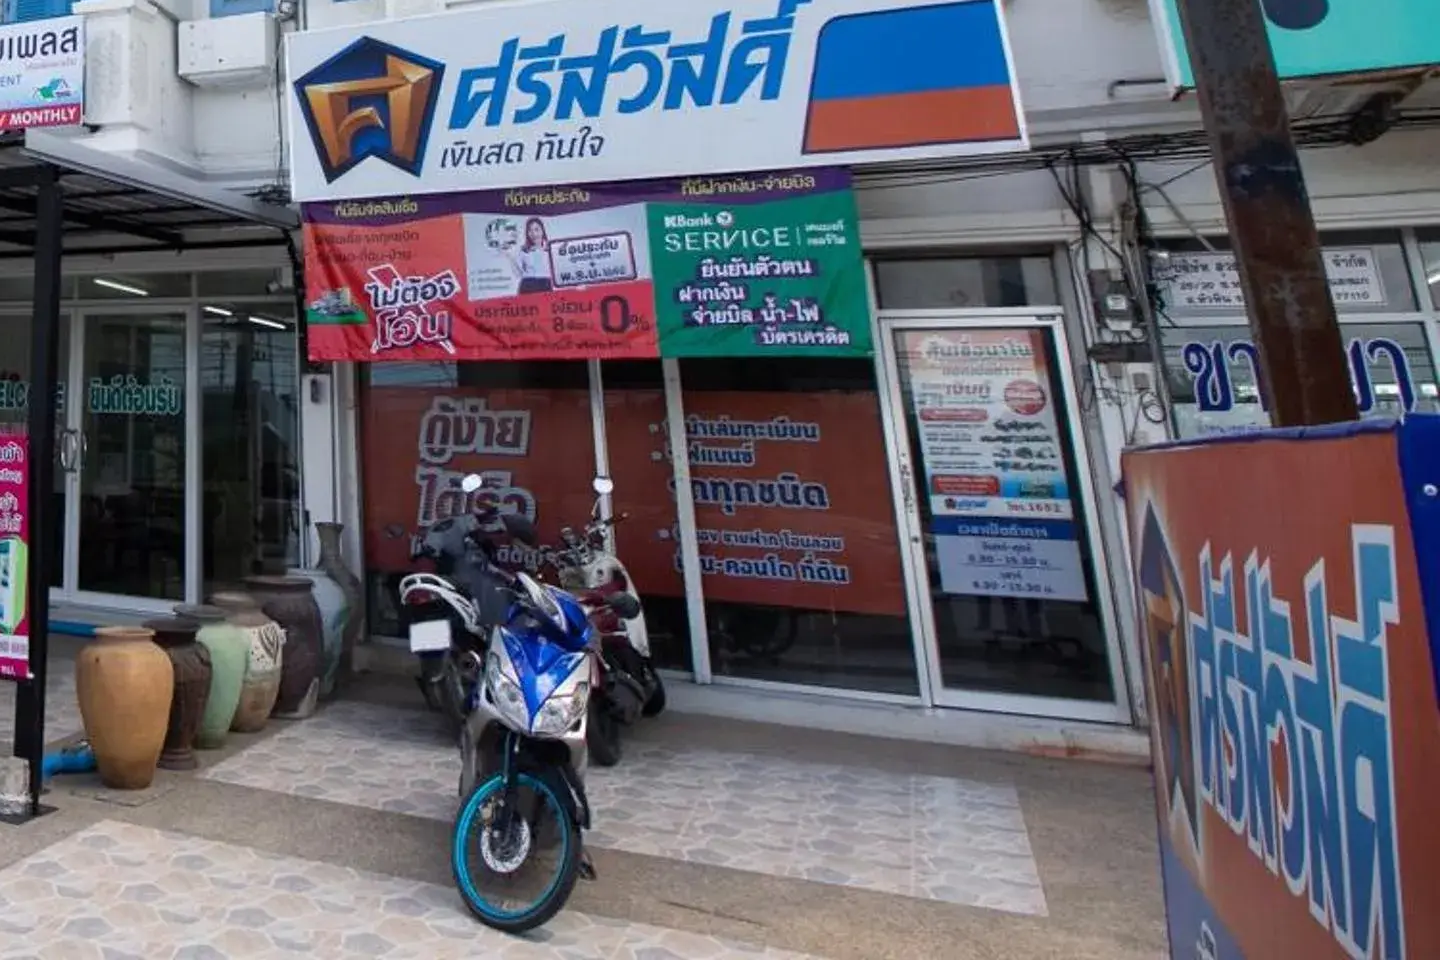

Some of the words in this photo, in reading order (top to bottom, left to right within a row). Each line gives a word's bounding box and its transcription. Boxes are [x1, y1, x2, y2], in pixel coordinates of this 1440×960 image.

[9, 106, 77, 127] MONTHLY
[440, 132, 525, 170] เงินสด
[534, 125, 605, 164] ทันใจ
[664, 213, 713, 228] KBank
[664, 227, 791, 253] SERVICE
[701, 255, 813, 278] ยืนยันตัวตน
[366, 270, 460, 309] ไม่ต้อง
[678, 281, 746, 302] ฝากเงิน
[692, 302, 754, 324] จ่ายบิล
[759, 296, 819, 323] น้ำ-ไฟ
[759, 326, 850, 346] บัตรเครดิต
[800, 551, 850, 584] ที่ดิน
